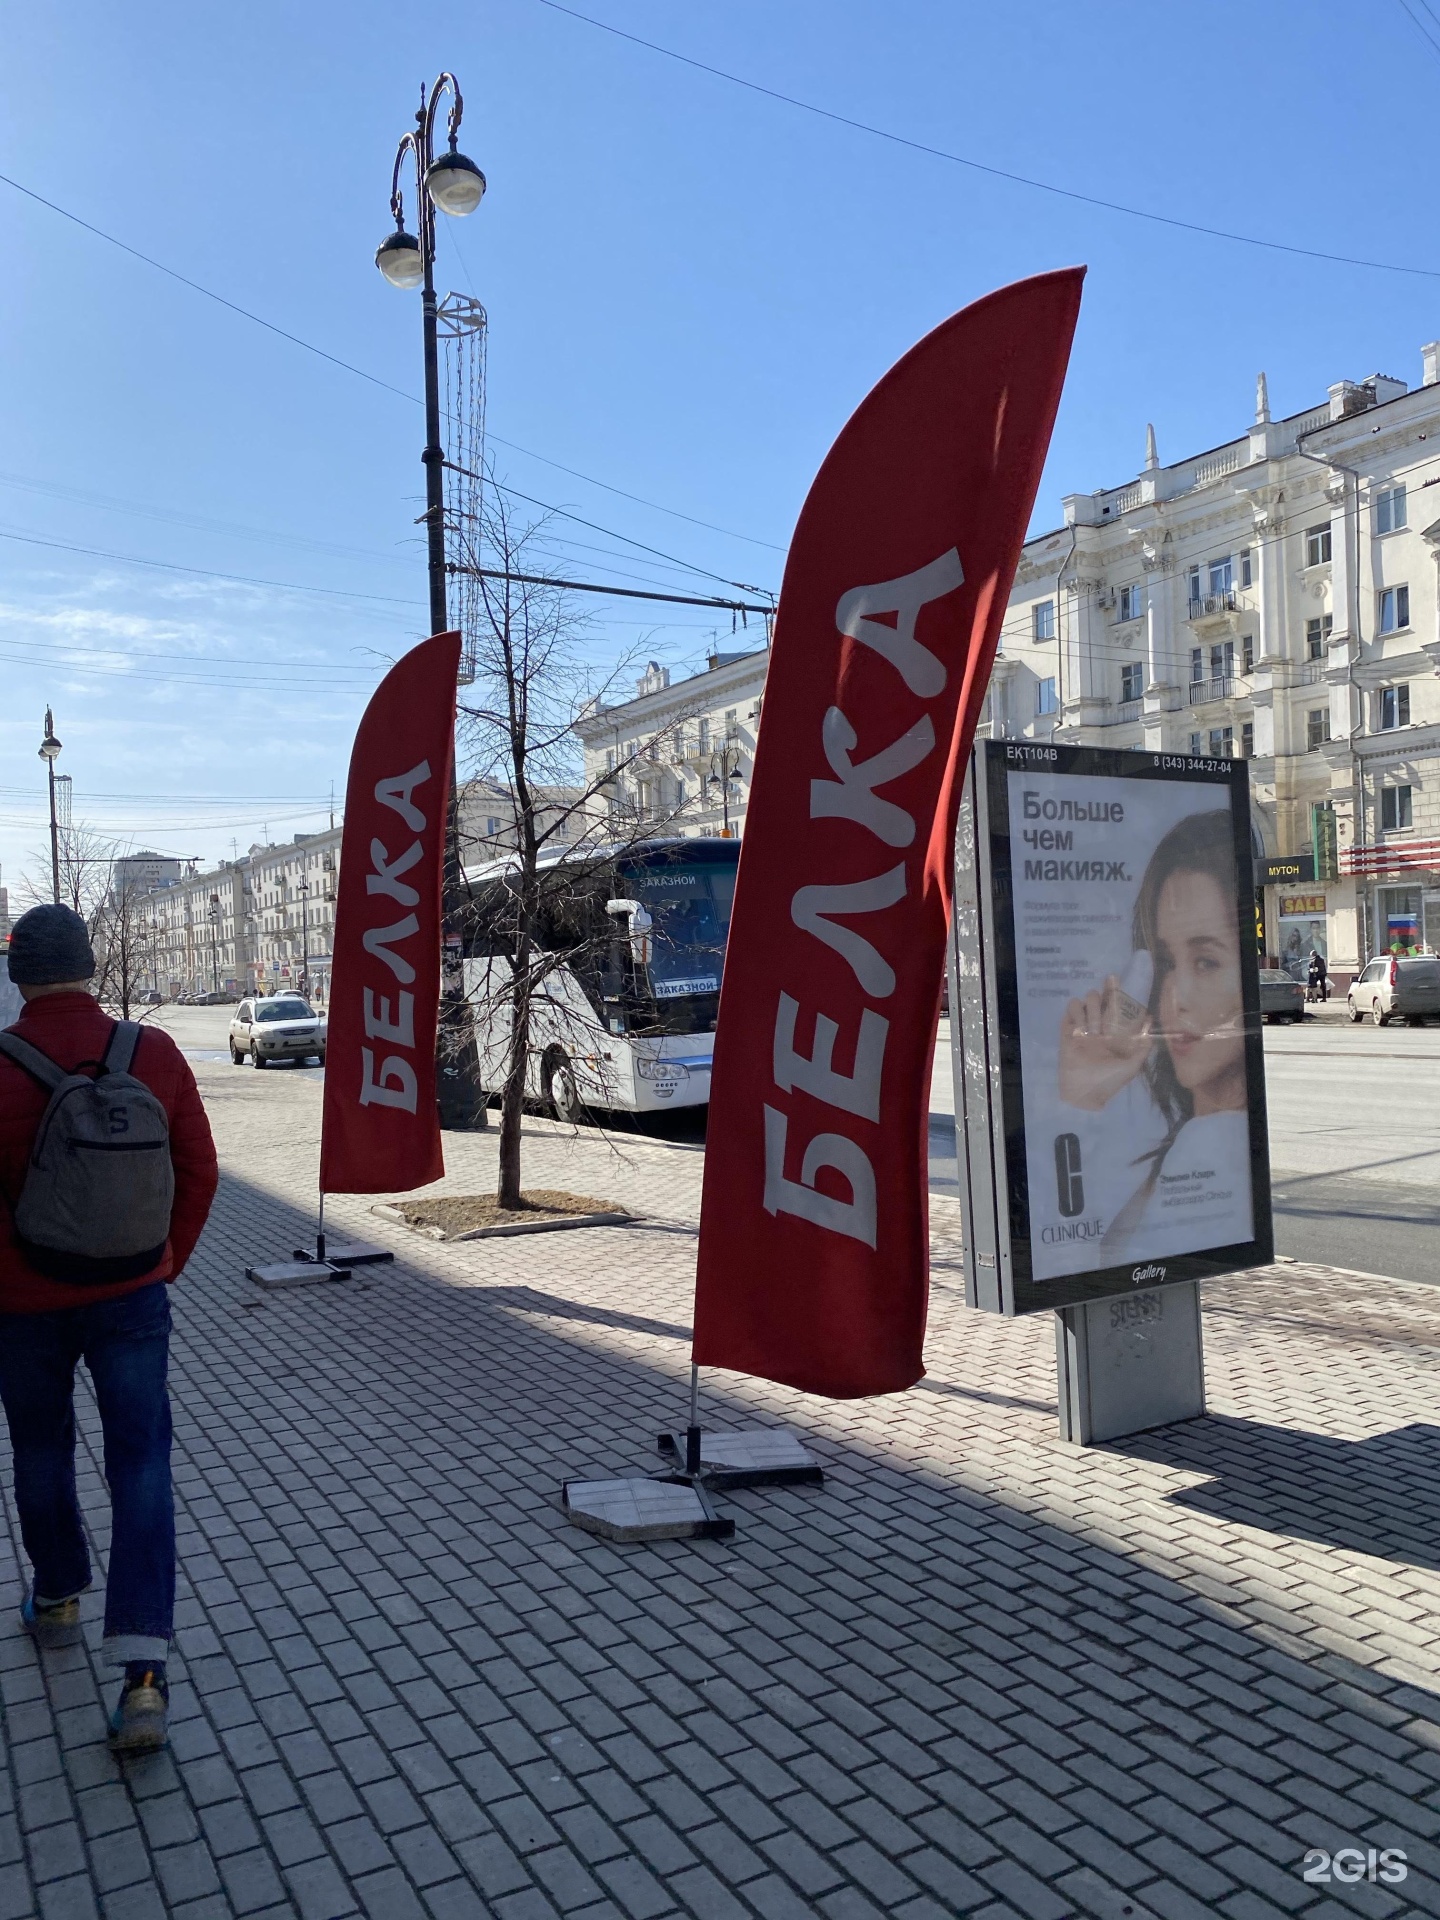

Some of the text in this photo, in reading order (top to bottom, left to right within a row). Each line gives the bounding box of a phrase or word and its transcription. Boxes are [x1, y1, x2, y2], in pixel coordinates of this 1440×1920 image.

[1153, 755, 1232, 773] 8 (343) 344-27-04
[1023, 791, 1125, 823] Больше
[1023, 829, 1074, 851] чем
[1024, 858, 1133, 882] макияж.
[1268, 866, 1300, 876] МУТОН
[762, 546, 966, 1252] БЕЛКА
[1284, 898, 1325, 913] SALE
[359, 759, 432, 1116] БЕЛКА
[109, 1106, 129, 1134] S
[1041, 1220, 1105, 1244] CLINIQUE
[1132, 1264, 1167, 1283] Gallery
